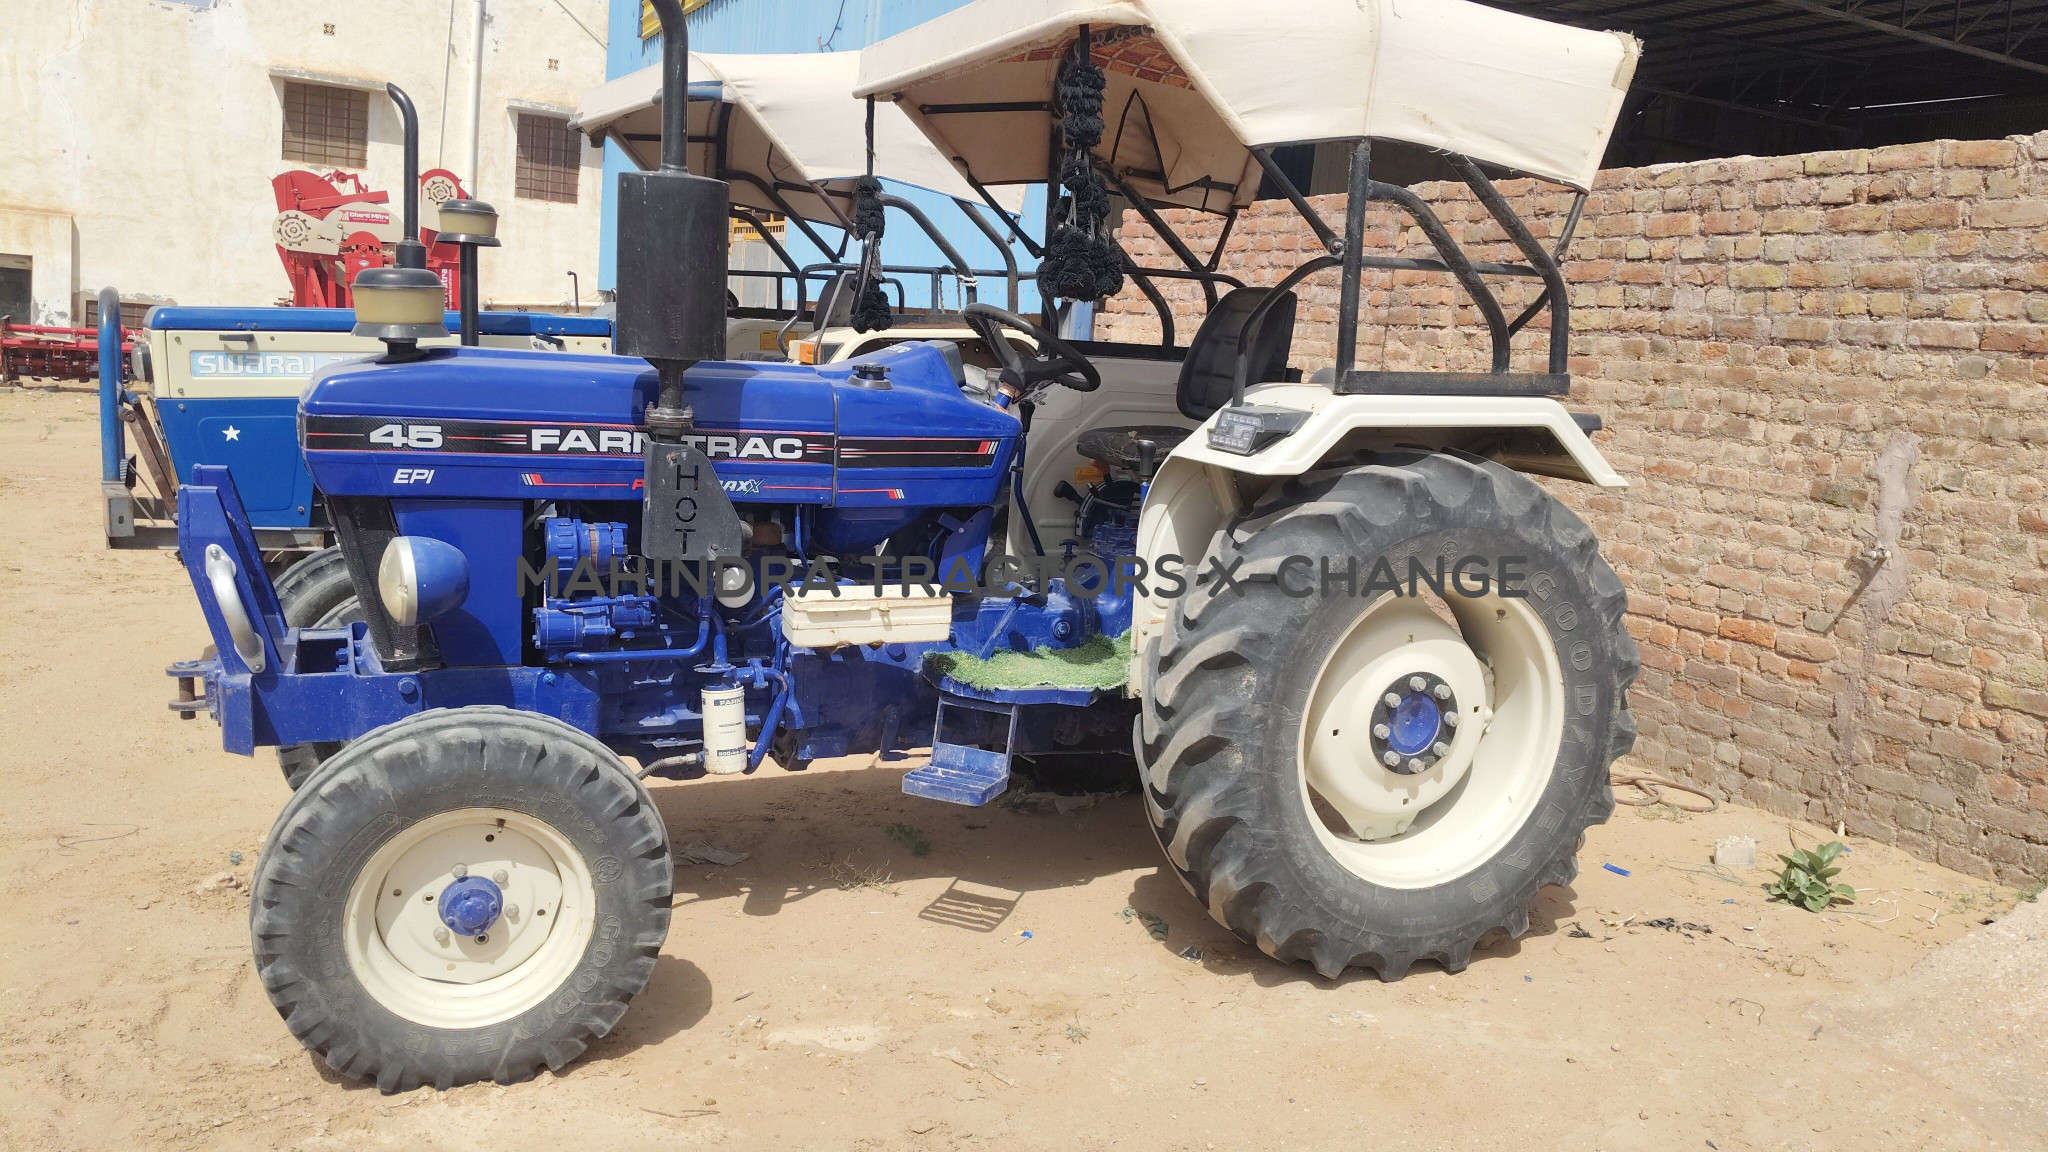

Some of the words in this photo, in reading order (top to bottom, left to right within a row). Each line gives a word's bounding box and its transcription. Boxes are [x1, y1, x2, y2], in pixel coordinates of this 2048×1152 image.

[369, 424, 443, 448] 45
[392, 468, 435, 484] EPI
[674, 465, 699, 555] HOT
